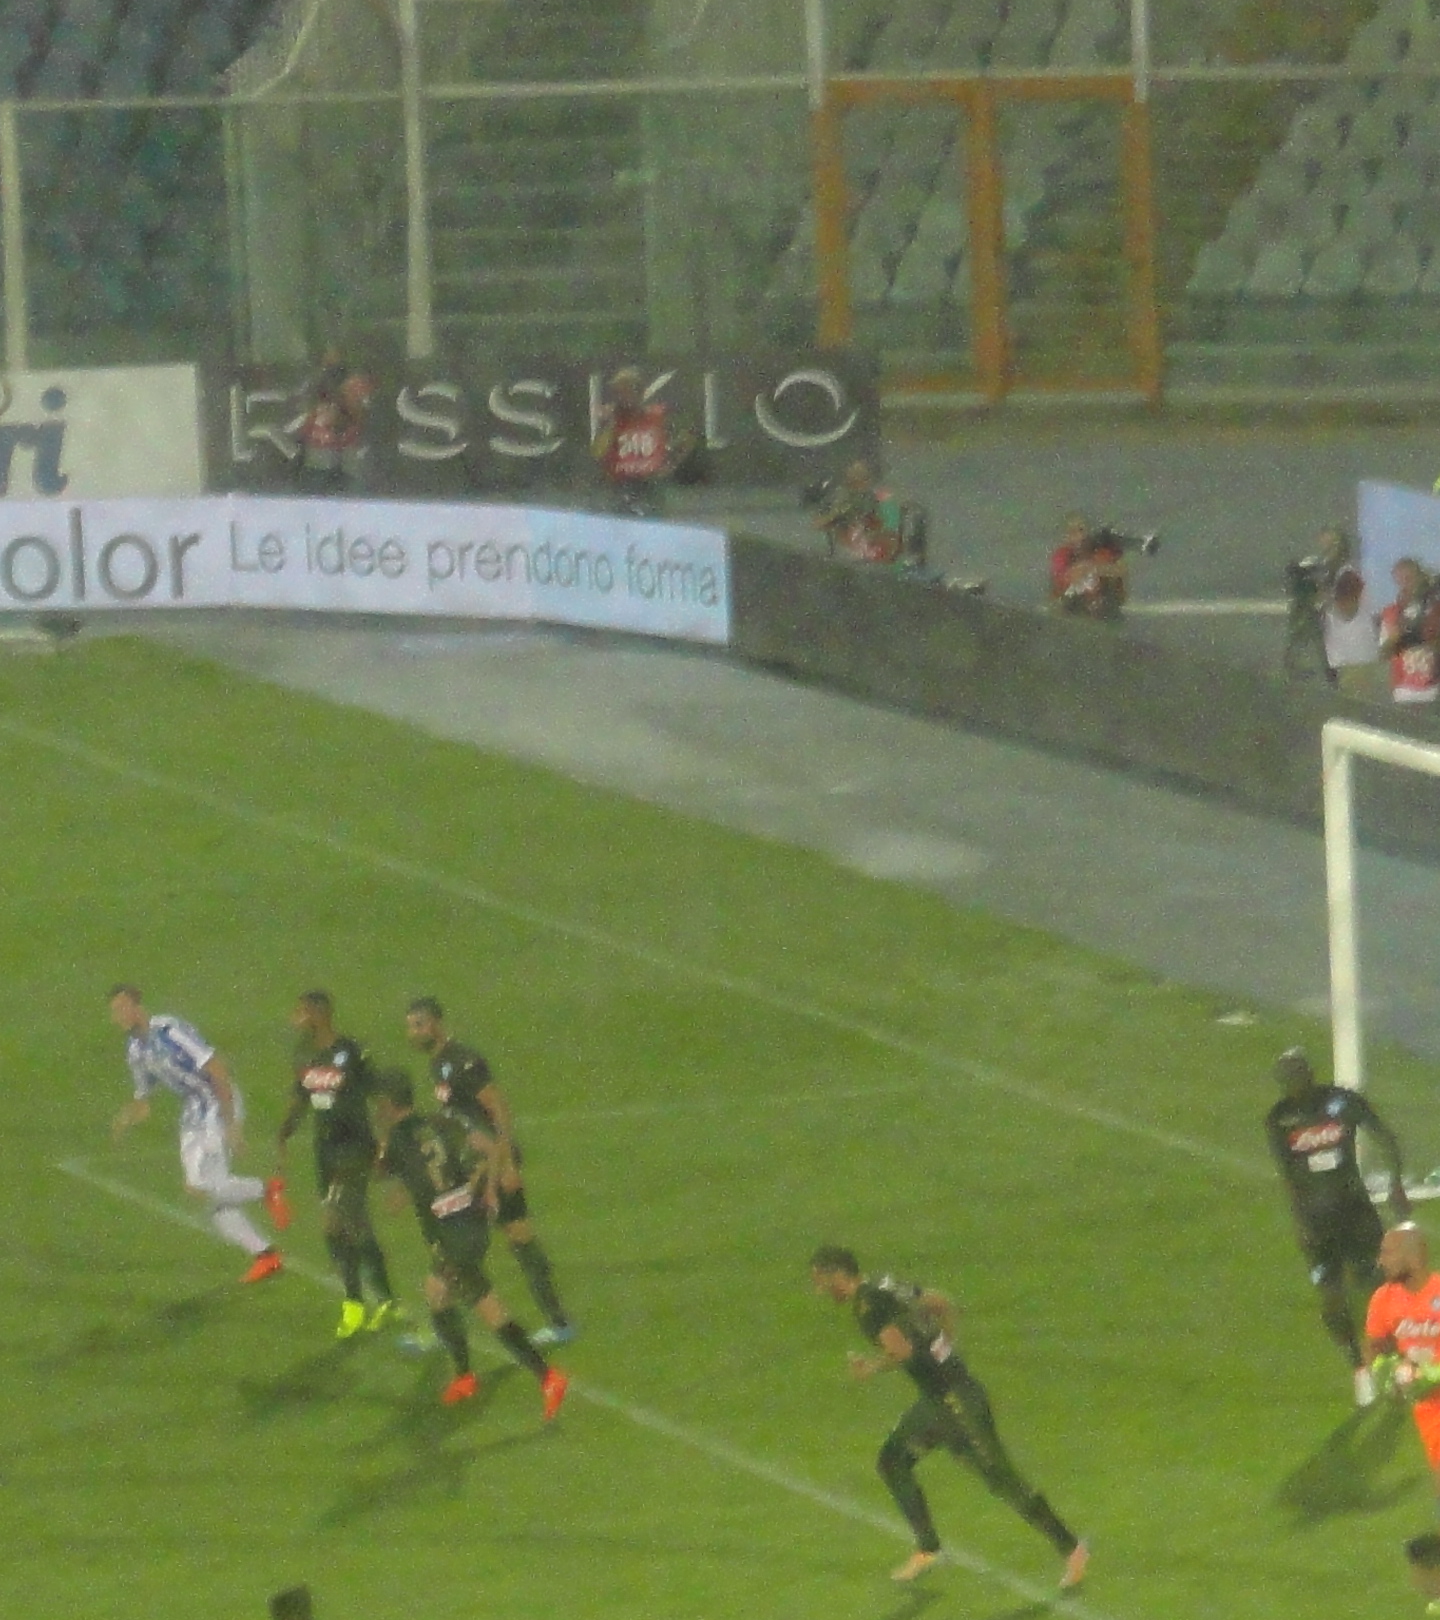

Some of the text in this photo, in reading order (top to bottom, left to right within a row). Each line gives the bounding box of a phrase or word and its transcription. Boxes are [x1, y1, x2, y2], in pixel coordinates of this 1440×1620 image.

[228, 368, 858, 462] RSSKIO
[228, 520, 286, 574] Le
[305, 523, 408, 579] idee
[427, 537, 615, 594] prendono
[626, 543, 718, 608] forma
